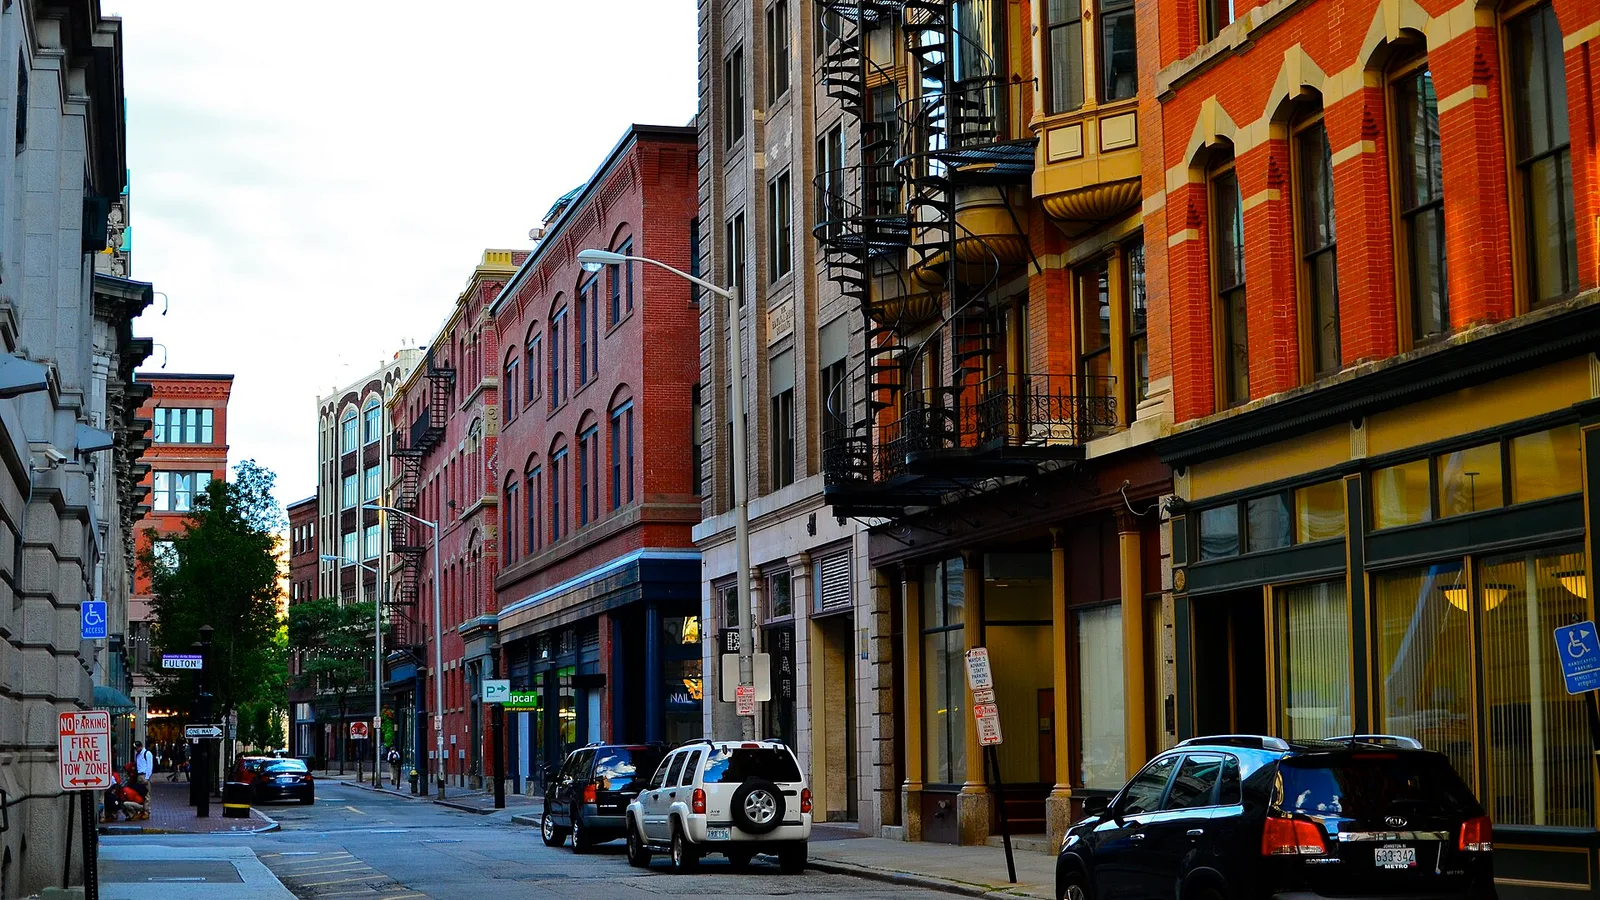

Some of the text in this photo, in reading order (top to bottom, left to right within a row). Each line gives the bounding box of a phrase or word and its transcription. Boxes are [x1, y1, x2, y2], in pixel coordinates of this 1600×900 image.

[486, 686, 496, 698] P
[509, 692, 534, 704] ipcar
[670, 692, 693, 703] NAIL
[60, 717, 107, 732] NO PARKING
[71, 737, 98, 748] FIRE
[70, 750, 100, 762] LANE
[63, 763, 108, 776] TOW ZONE
[1389, 817, 1404, 825] KIA
